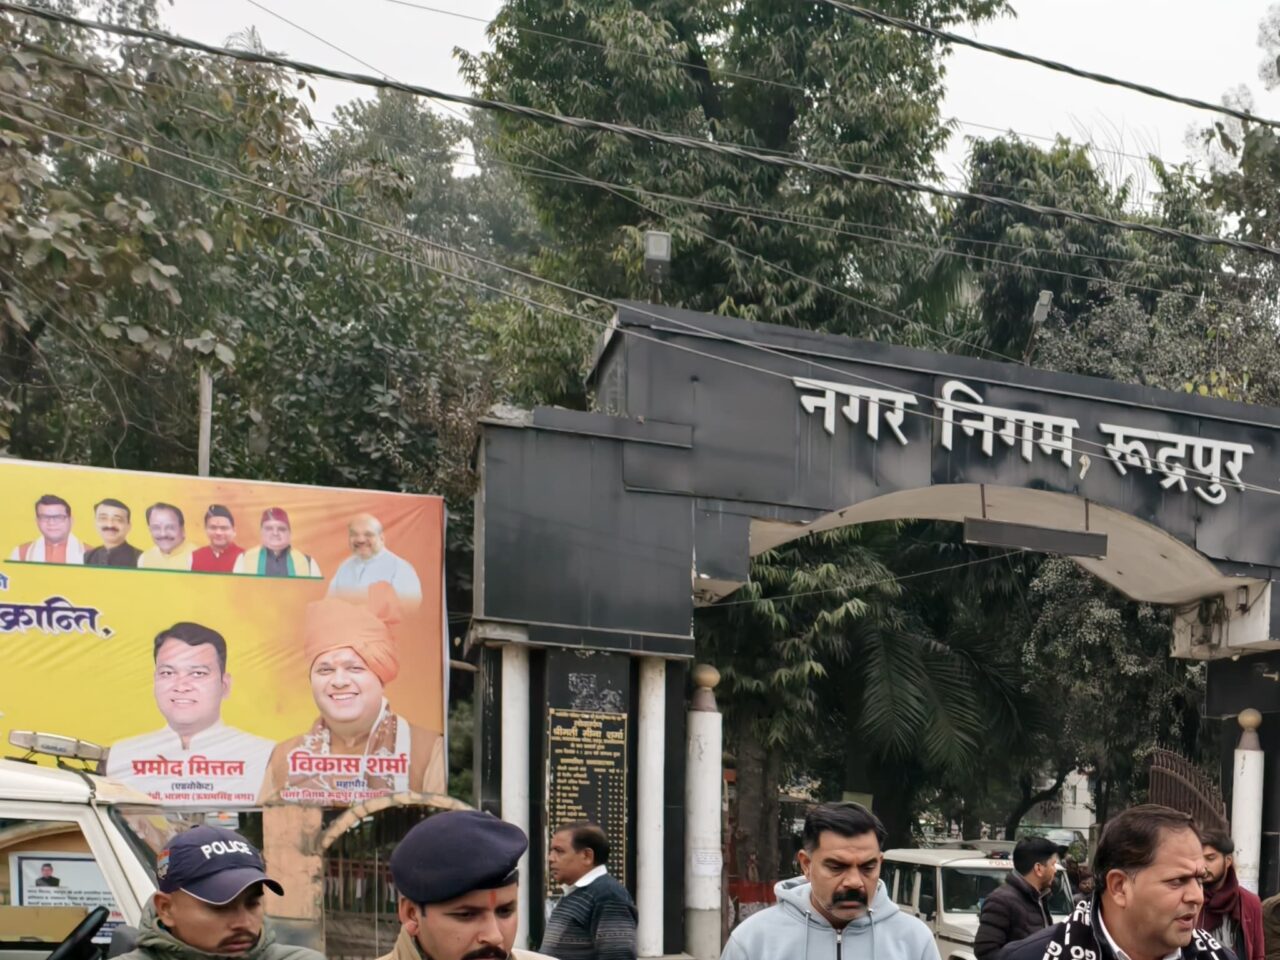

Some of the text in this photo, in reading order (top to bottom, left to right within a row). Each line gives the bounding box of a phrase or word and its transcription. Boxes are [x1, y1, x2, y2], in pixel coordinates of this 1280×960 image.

[792, 376, 1255, 505] नगर निगम, रूद्रपुर
[132, 754, 244, 776] प्रमोद मित्तल
[290, 751, 407, 773] विकास शर्मा
[200, 841, 253, 860] POLICE
